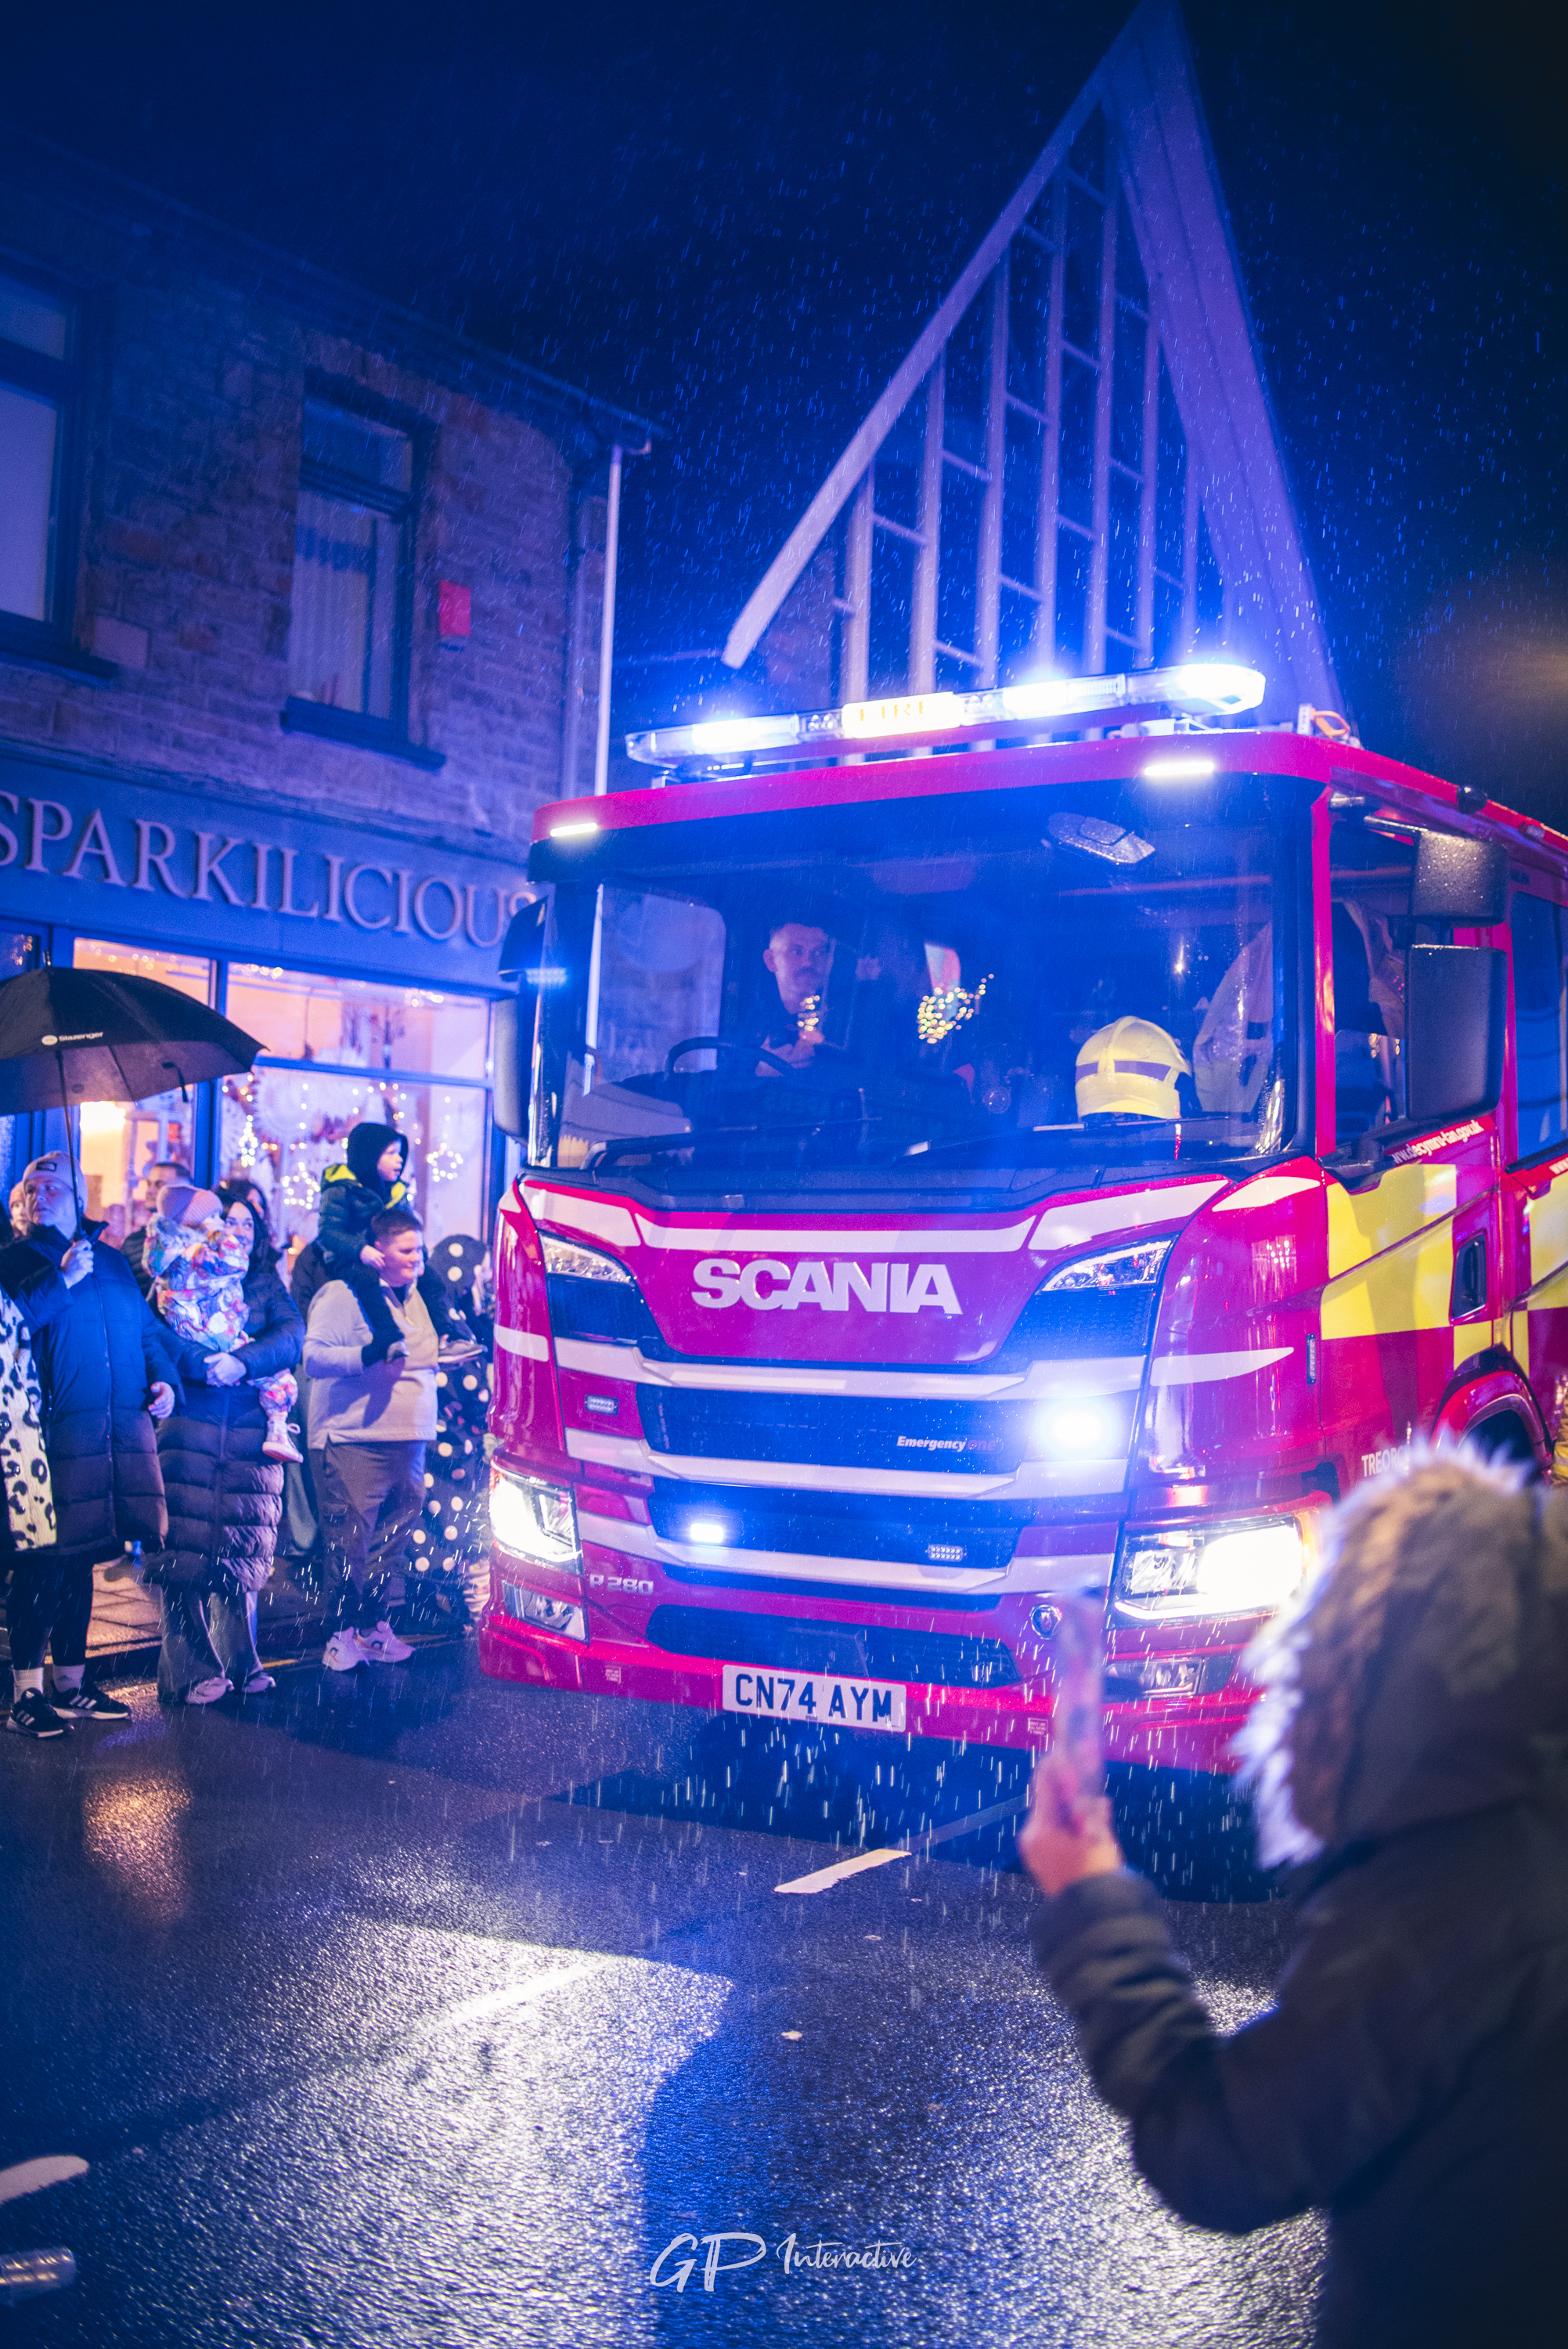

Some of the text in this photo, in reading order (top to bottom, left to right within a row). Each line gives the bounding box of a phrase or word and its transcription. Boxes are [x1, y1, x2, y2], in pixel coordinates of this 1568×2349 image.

[691, 1258, 963, 1314] SCANIA
[896, 1435, 967, 1452] Emergency
[735, 1672, 892, 1723] CN74 AYM
